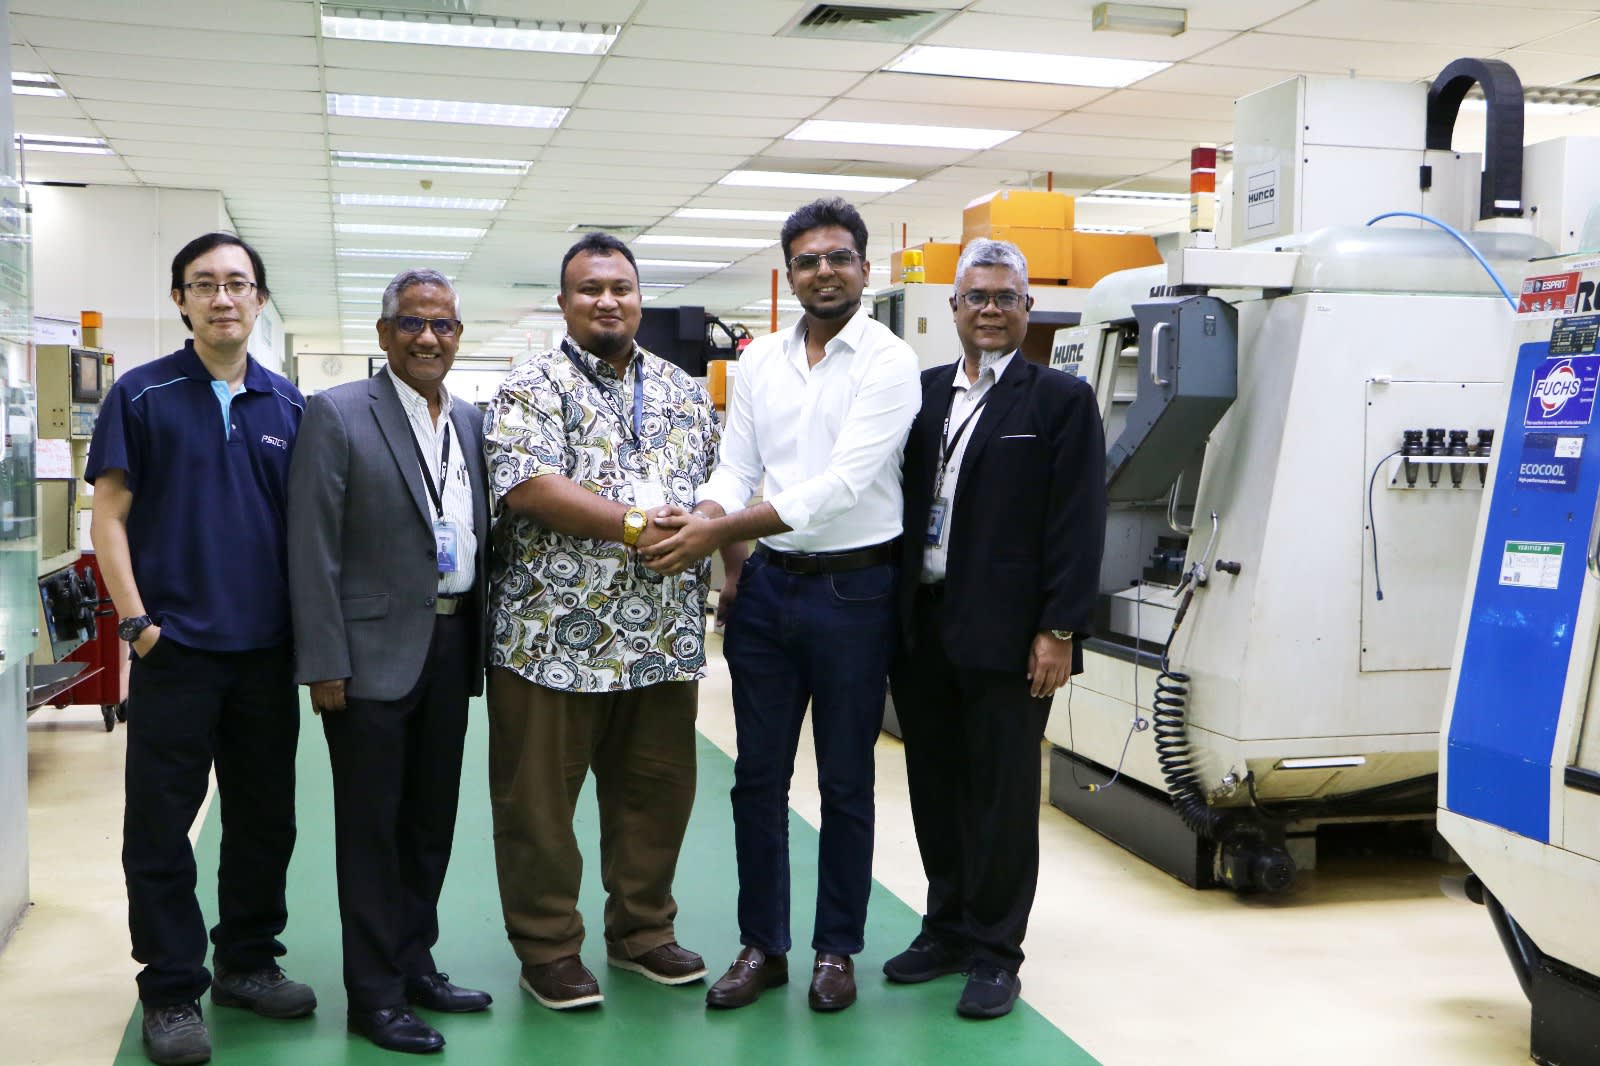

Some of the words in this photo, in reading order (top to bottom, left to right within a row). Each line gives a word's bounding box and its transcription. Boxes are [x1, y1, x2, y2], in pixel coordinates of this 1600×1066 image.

[1248, 188, 1274, 203] HURCO
[1542, 280, 1567, 290] ESPRIT
[1534, 380, 1579, 396] FUCHS
[1519, 463, 1565, 477] ECOCOOL
